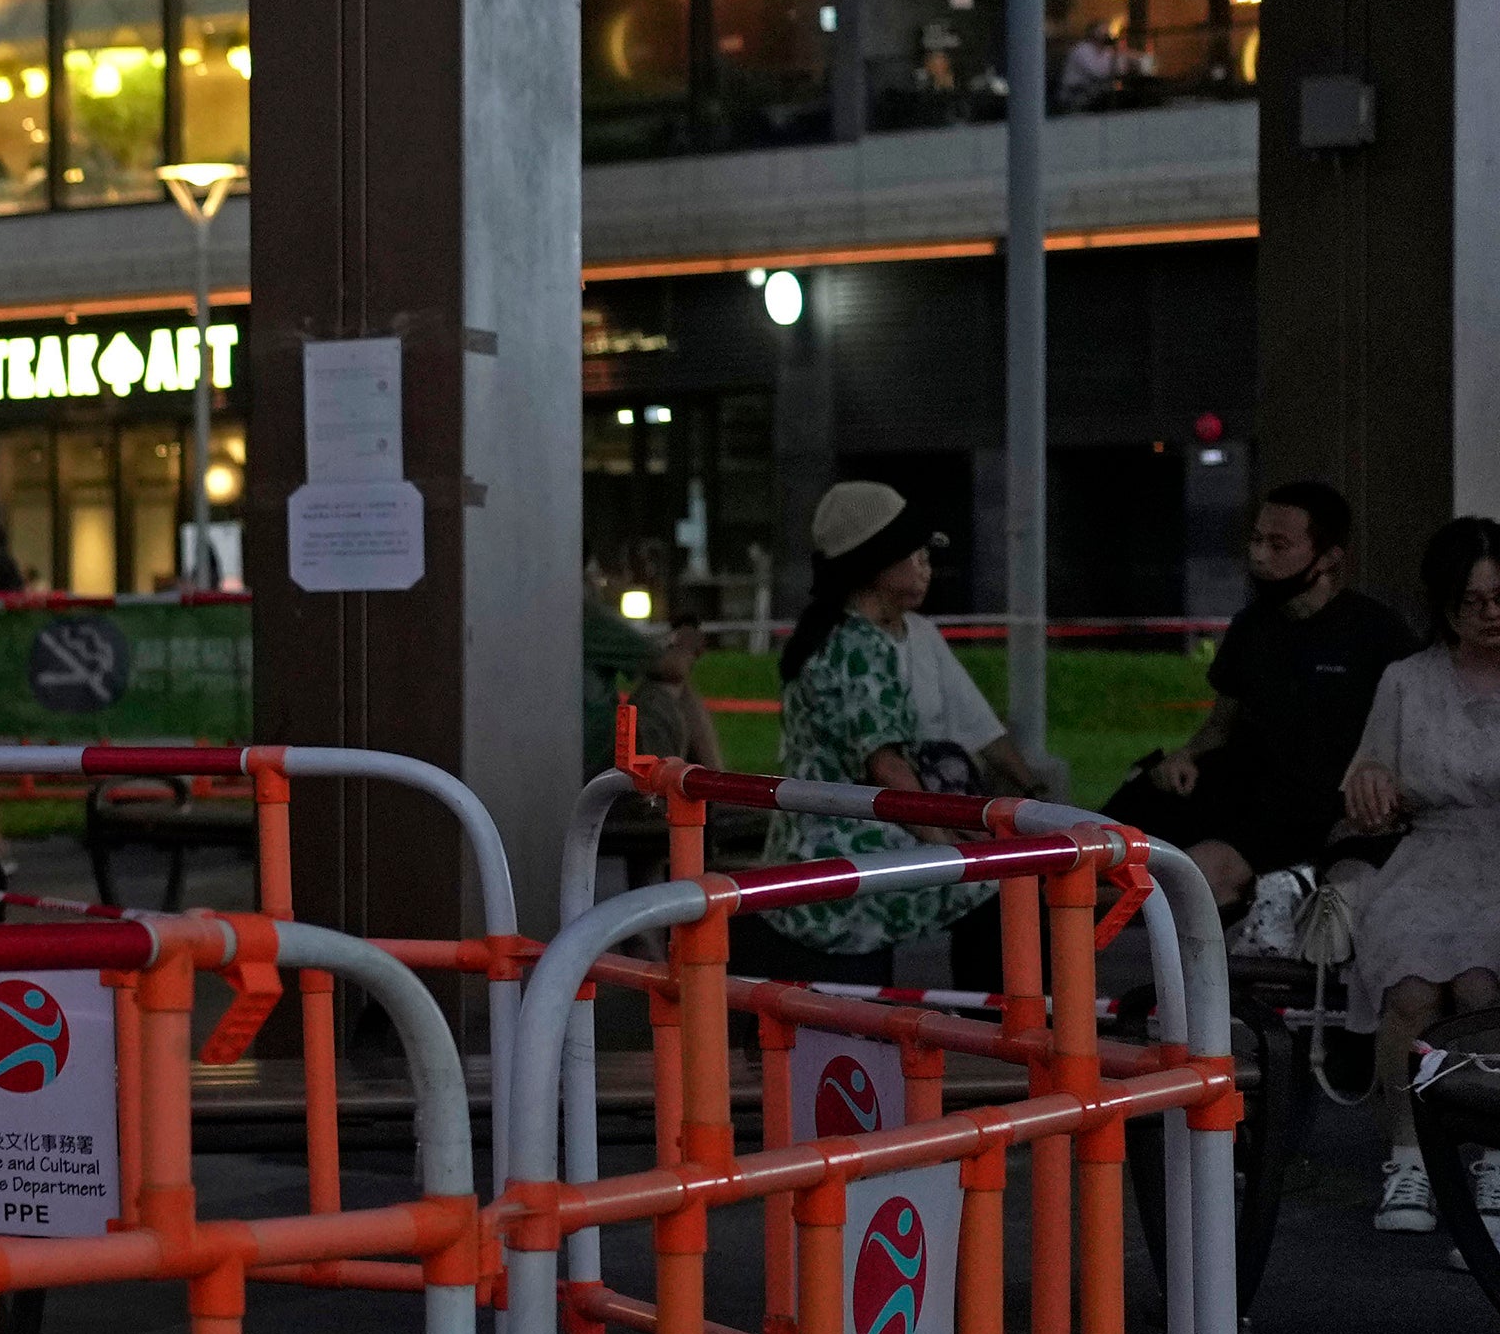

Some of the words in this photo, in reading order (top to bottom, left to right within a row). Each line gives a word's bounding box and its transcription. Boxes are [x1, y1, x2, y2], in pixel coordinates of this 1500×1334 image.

[8, 1157, 35, 1172] and
[40, 1157, 100, 1175] Cultural
[13, 1176, 107, 1198] Department
[3, 1203, 50, 1224] PPE
